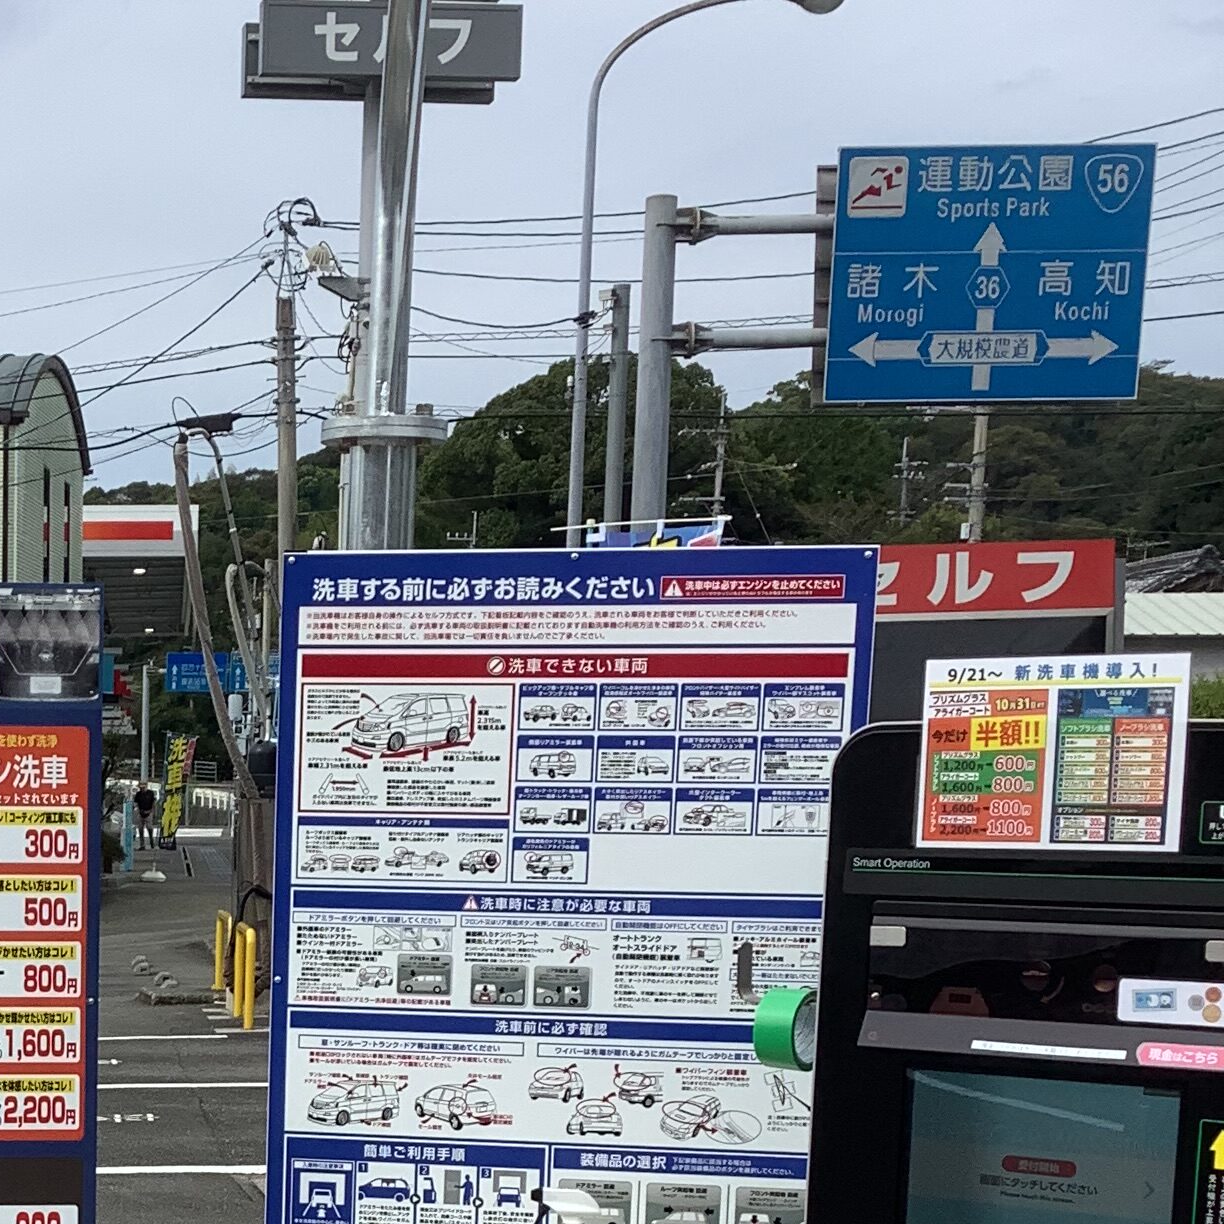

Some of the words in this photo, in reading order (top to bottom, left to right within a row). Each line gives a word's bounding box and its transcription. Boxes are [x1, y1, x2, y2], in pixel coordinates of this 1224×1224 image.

[918, 154, 1075, 193] 運動公園
[1097, 164, 1129, 194] 56
[937, 197, 999, 222] Sports
[1005, 197, 1050, 217] Park
[847, 263, 940, 299] 諸木
[975, 276, 1000, 300] 36
[1038, 259, 1131, 297] 高知
[857, 304, 925, 327] Morogi
[1055, 300, 1110, 322] Kochi
[936, 337, 1030, 361] 大規模農道
[312, 576, 654, 601] 洗車する前に必ずお読みください
[507, 657, 649, 674] 洗車できない車両
[932, 693, 987, 705] プリズムグラス
[934, 705, 990, 717] アライガーコート
[931, 729, 969, 743] 今だけ
[993, 755, 1035, 772] 600円
[992, 776, 1034, 793] 800円
[990, 800, 1032, 816] 800円
[24, 829, 79, 860] 300円
[852, 857, 883, 870] Smart
[883, 858, 931, 871] Operation
[24, 897, 78, 928] 500円
[480, 896, 651, 914] 洗車時に注意が必要な車両
[612, 934, 662, 943] オートトランク
[23, 965, 78, 994] 800円
[495, 1019, 608, 1037] 洗車前に必ず確認
[5, 1028, 77, 1062] 1,600円
[1147, 1047, 1219, 1065] 現金はこちら
[4, 1095, 76, 1128] 2,200円
[363, 1143, 466, 1162] 簡単ご利用手順
[580, 1152, 667, 1171] 装備品の選択
